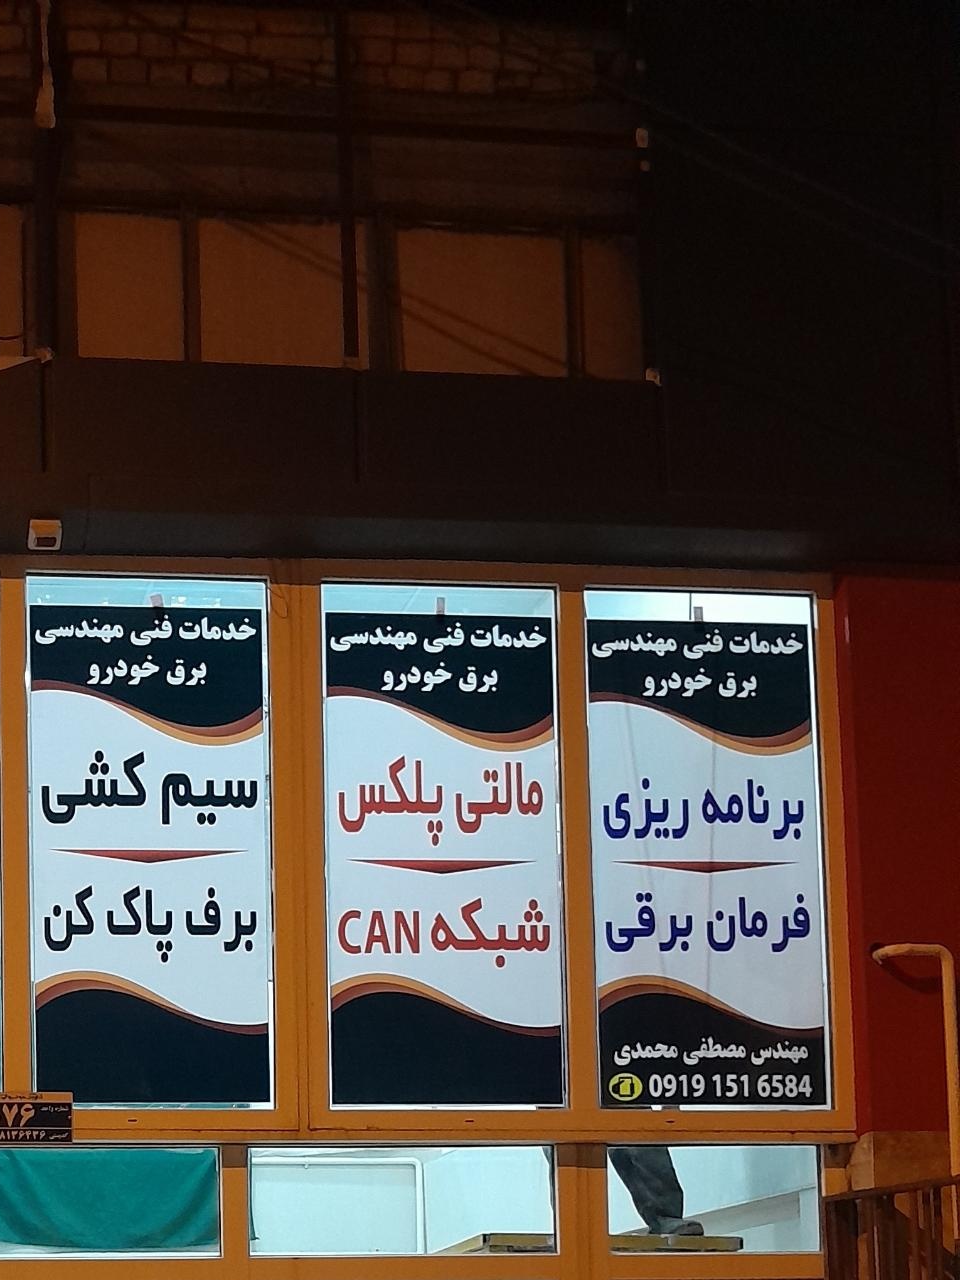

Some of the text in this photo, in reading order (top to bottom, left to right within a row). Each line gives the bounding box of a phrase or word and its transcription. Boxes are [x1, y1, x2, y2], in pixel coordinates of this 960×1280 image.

[35, 615, 256, 645] خدمات فنی مهندسی
[331, 623, 546, 652] خدمات فنی مهندسی
[592, 629, 803, 659] خدمات فنی مهندسی
[87, 655, 206, 685] برق خودرو
[381, 662, 497, 692] برق خودرو
[643, 668, 756, 697] برق خودرو
[42, 751, 257, 825] سیم کشی
[339, 756, 543, 846] مالتی پلکس
[603, 778, 803, 839] برنامه ریزی
[45, 886, 256, 962] برف پاک کن
[338, 898, 550, 967] شبکه CAN
[606, 893, 810, 952] فرمان برقی
[614, 1037, 808, 1065] مهندس مصطفی محمدی
[649, 1074, 812, 1097] 0919 151 6584
